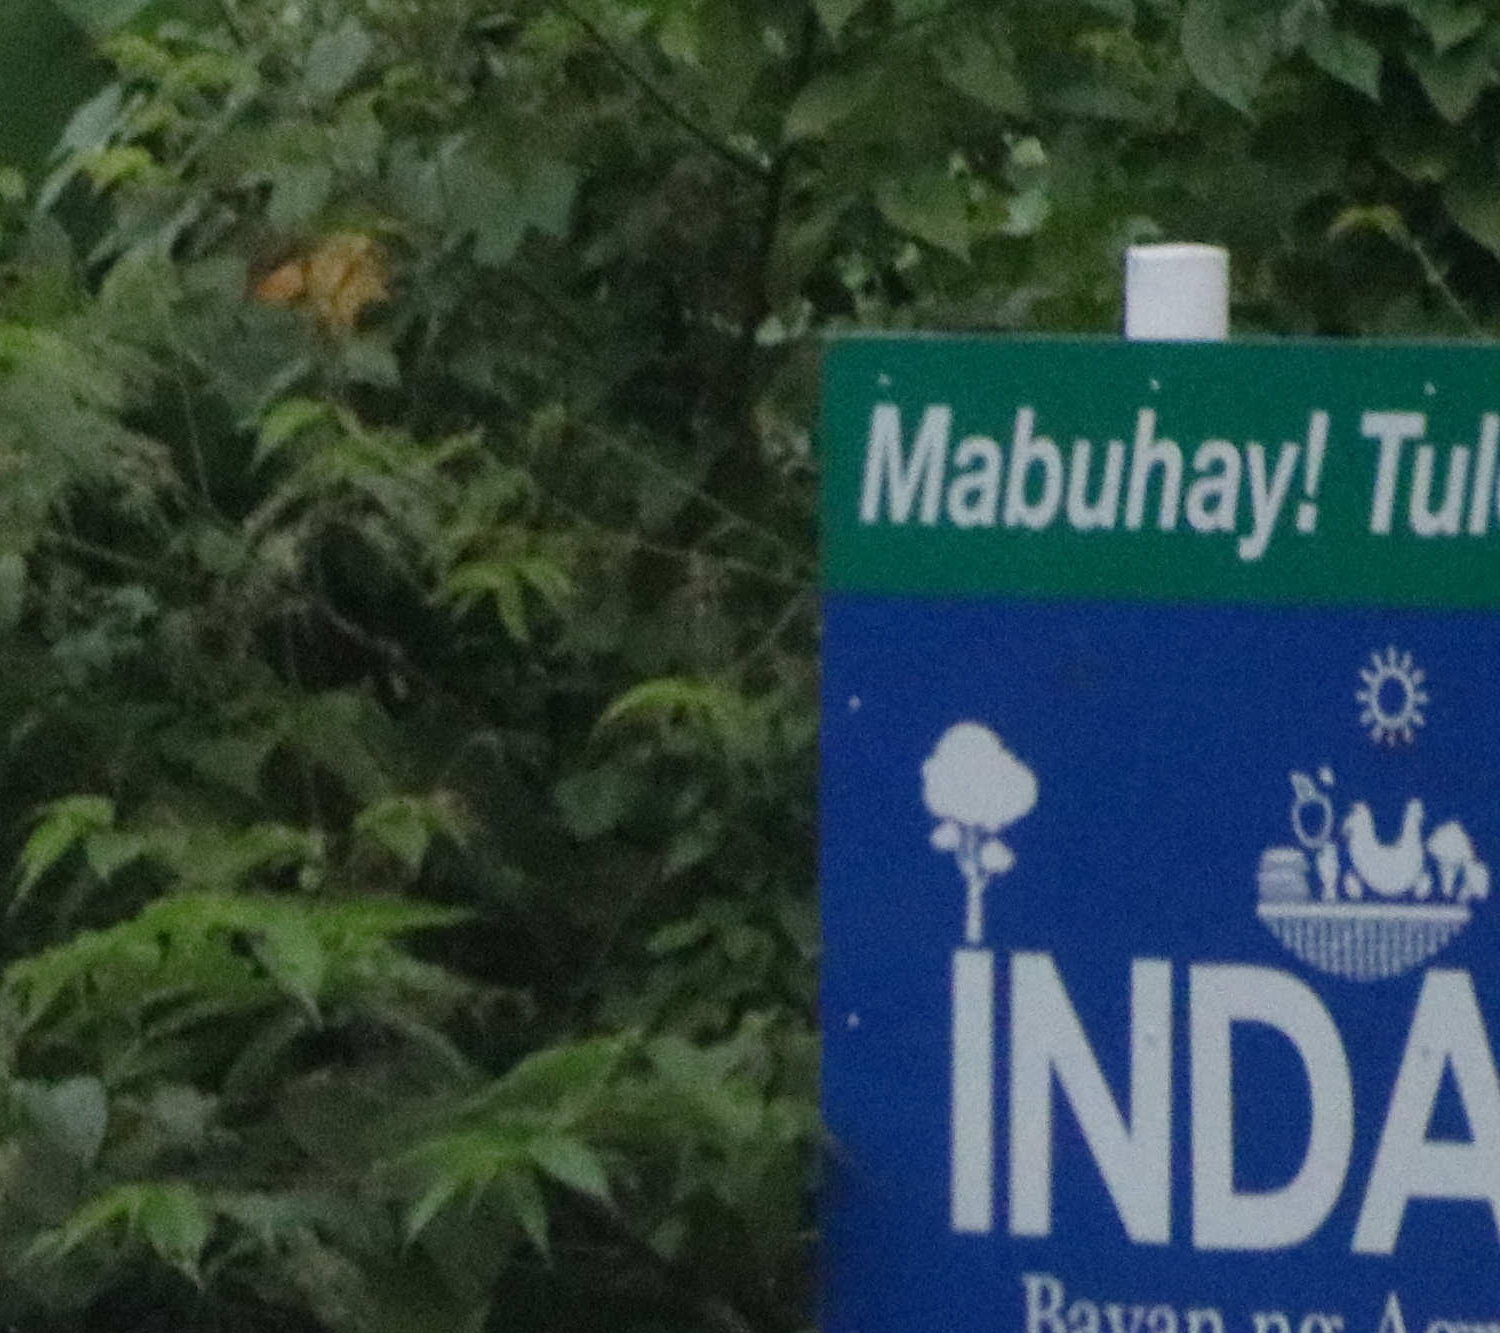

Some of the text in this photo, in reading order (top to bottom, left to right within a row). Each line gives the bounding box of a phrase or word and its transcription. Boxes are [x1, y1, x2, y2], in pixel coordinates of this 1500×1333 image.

[860, 403, 1500, 561] Mabuhay! Tul
[949, 947, 1500, 1256] INDA
